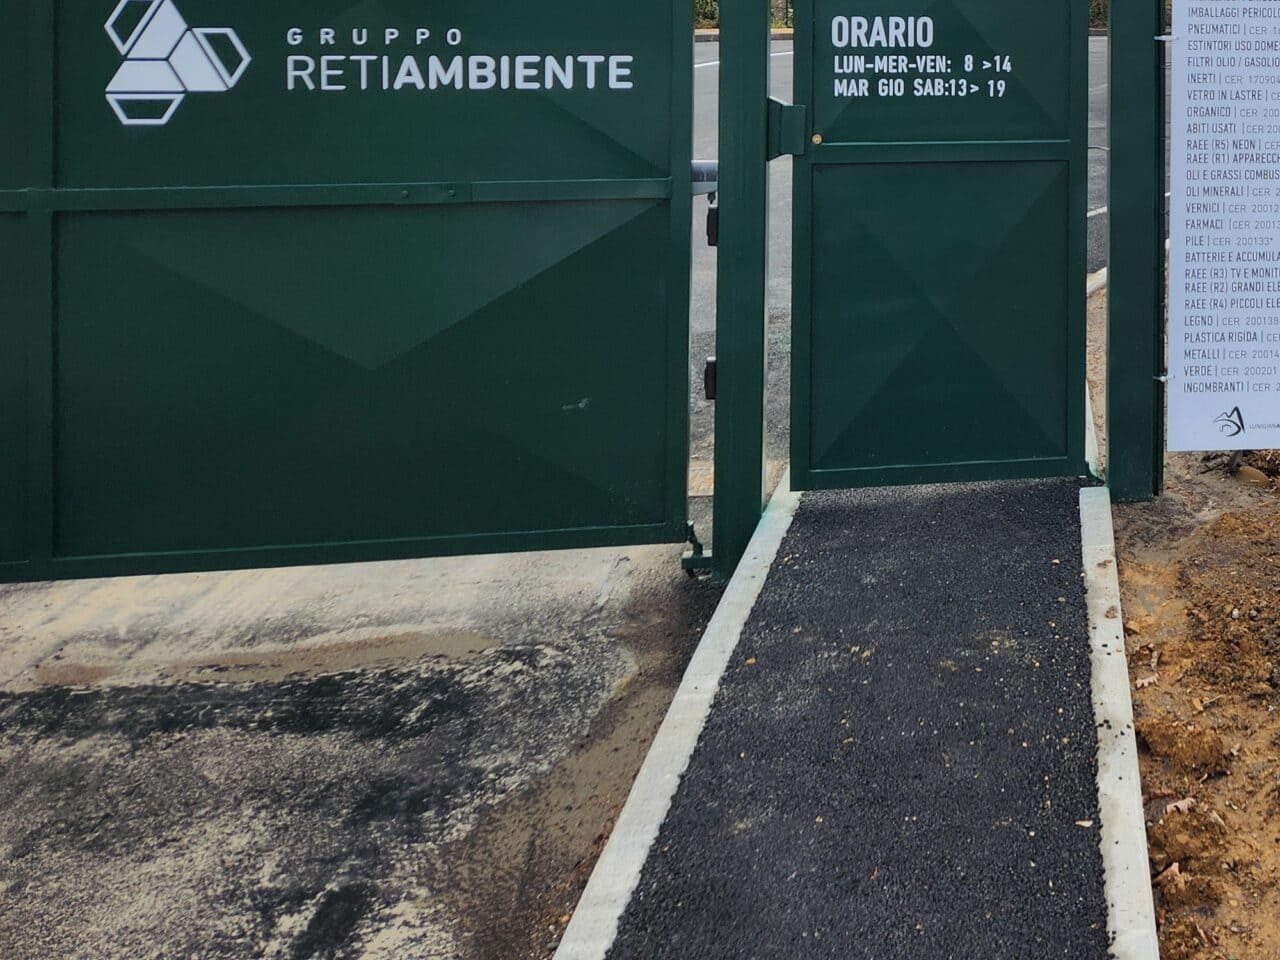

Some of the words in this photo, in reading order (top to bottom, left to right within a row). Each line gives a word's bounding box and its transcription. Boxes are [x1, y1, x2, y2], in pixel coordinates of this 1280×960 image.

[1188, 8, 1239, 18] IMBALLAGGI
[832, 15, 934, 47] ORARIO
[1188, 24, 1240, 35] PNEUMATICI
[287, 28, 463, 46] GRUPPO
[1187, 41, 1232, 51] ESTINTORI
[1234, 41, 1252, 51] USO
[834, 55, 951, 73] LUN-MER-VEN:
[964, 54, 973, 72] 8
[1187, 57, 1213, 67] FILTRI
[1216, 57, 1236, 68] OLIO
[1244, 57, 1280, 68] GASOLIO
[287, 55, 634, 90] RETIAMBIENTE
[1187, 73, 1216, 84] INERTI
[834, 79, 869, 97] MAR
[878, 78, 905, 97] GIO
[988, 80, 1006, 97] 19
[1187, 90, 1215, 100] VETRO
[1218, 90, 1227, 101] IN
[1230, 90, 1263, 101] LASTRE
[1187, 107, 1231, 117] ORGANICO
[1240, 108, 1257, 117] CER
[1186, 123, 1209, 134] ABITI
[1212, 123, 1236, 134] USATI
[1246, 125, 1264, 134] CER
[1186, 139, 1208, 150] RAEE
[1211, 139, 1229, 151] (R5)
[1232, 139, 1256, 150] NEON
[1186, 153, 1208, 164] RAEE
[1211, 153, 1230, 164] (R1)
[1186, 170, 1199, 181] OLI
[1203, 170, 1208, 180] E
[1211, 170, 1241, 180] GRASSI
[1186, 186, 1200, 197] OLI
[1203, 186, 1244, 197] MINERALI
[1186, 203, 1219, 213] VERNICI
[1186, 219, 1223, 230] FARMACI
[1233, 221, 1250, 229] CER
[1186, 236, 1204, 246] PILE
[1185, 252, 1226, 263] BATTERIE
[1229, 252, 1233, 263] E
[1185, 268, 1207, 279] RAEE
[1210, 268, 1228, 279] (R3)
[1231, 268, 1241, 279] TV
[1244, 268, 1249, 279] E
[1185, 282, 1207, 293] RAEE
[1210, 282, 1229, 293] (R2)
[1231, 282, 1264, 293] GRANDI
[1185, 299, 1207, 310] RAEE
[1210, 299, 1228, 310] (R4)
[1231, 298, 1263, 309] PICCOLI
[1184, 316, 1213, 326] LEGNO
[1222, 317, 1239, 326] CER
[1184, 332, 1226, 343] PLASTICA
[1228, 332, 1257, 342] RIGIDA
[1184, 349, 1220, 360] METALLI
[1229, 350, 1246, 359] CER
[1184, 366, 1212, 377] VERDE
[1221, 368, 1239, 376] CER
[1184, 382, 1244, 393] INGOMBRANTI
[1253, 383, 1270, 392] CER
